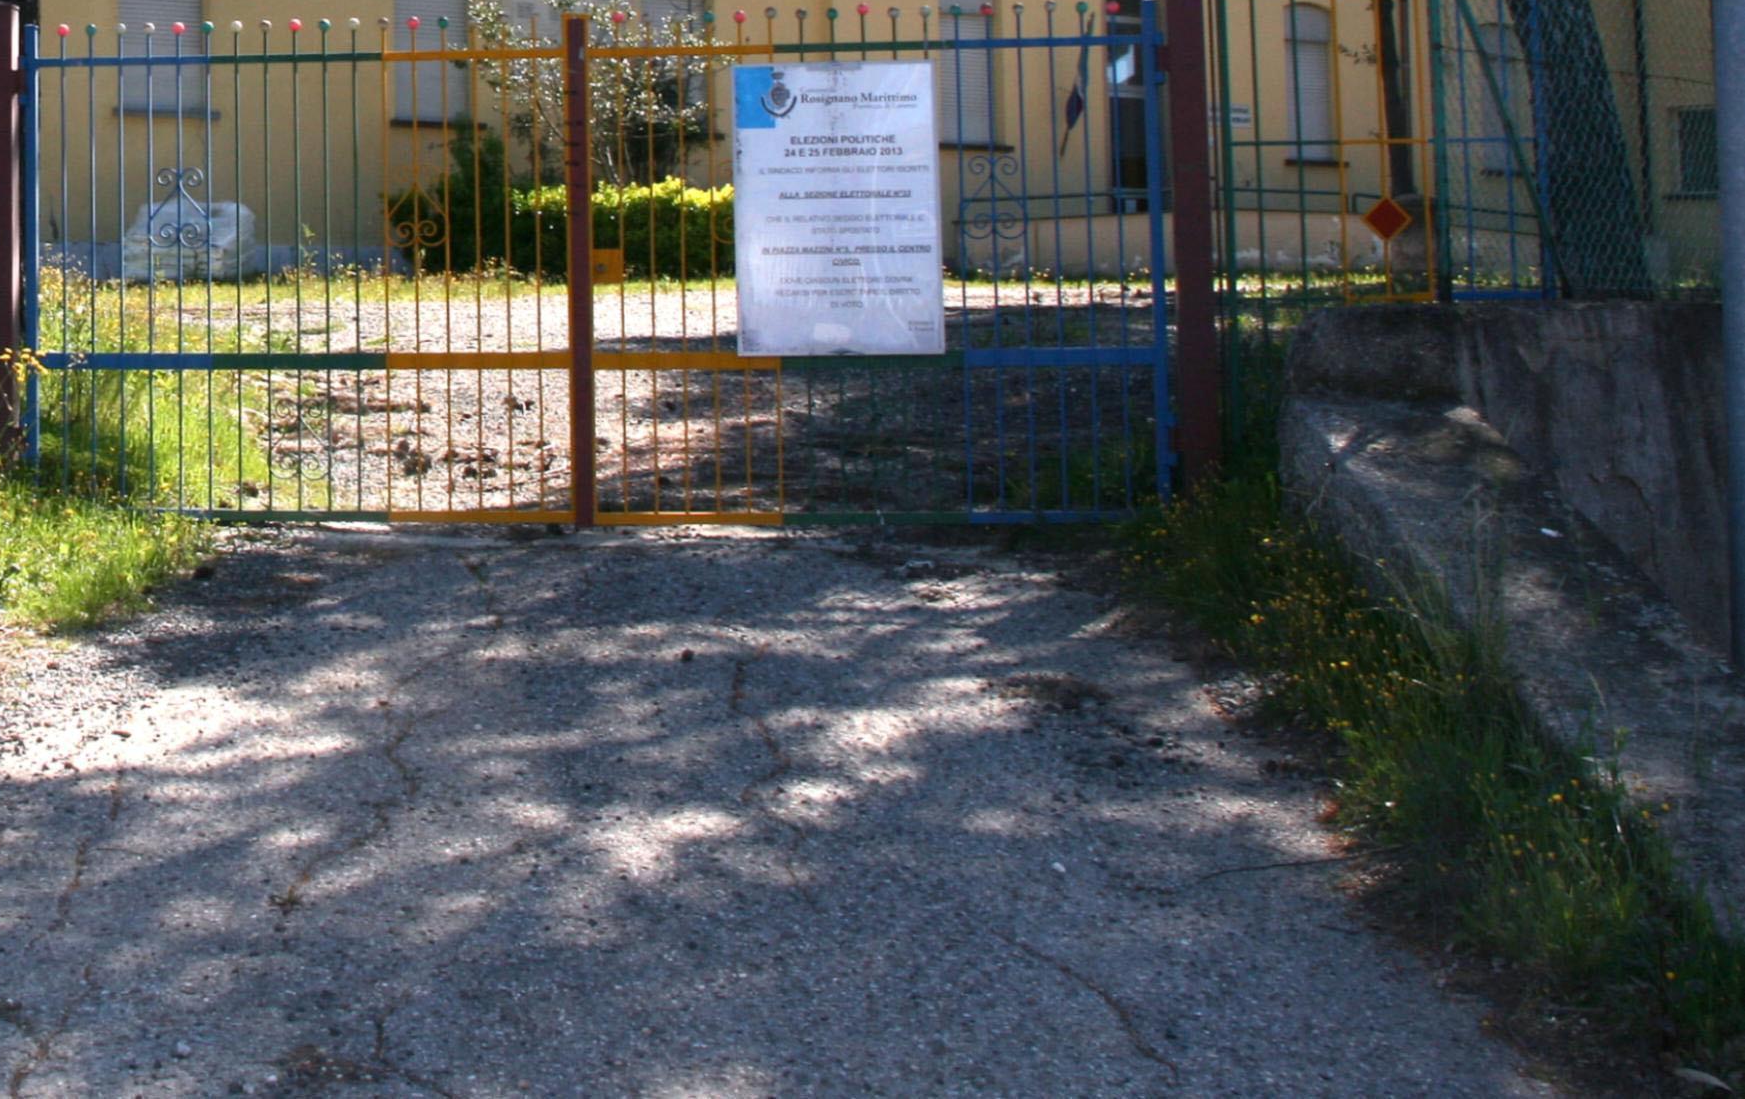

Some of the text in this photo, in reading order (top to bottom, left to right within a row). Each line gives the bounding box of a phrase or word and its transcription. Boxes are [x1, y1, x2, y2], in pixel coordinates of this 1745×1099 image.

[800, 92, 918, 106] Rosignano Marittimo
[790, 134, 896, 145] ELEZIONI POLITICHE
[784, 146, 903, 157] 24 E 25 FEBBRAIO 2013
